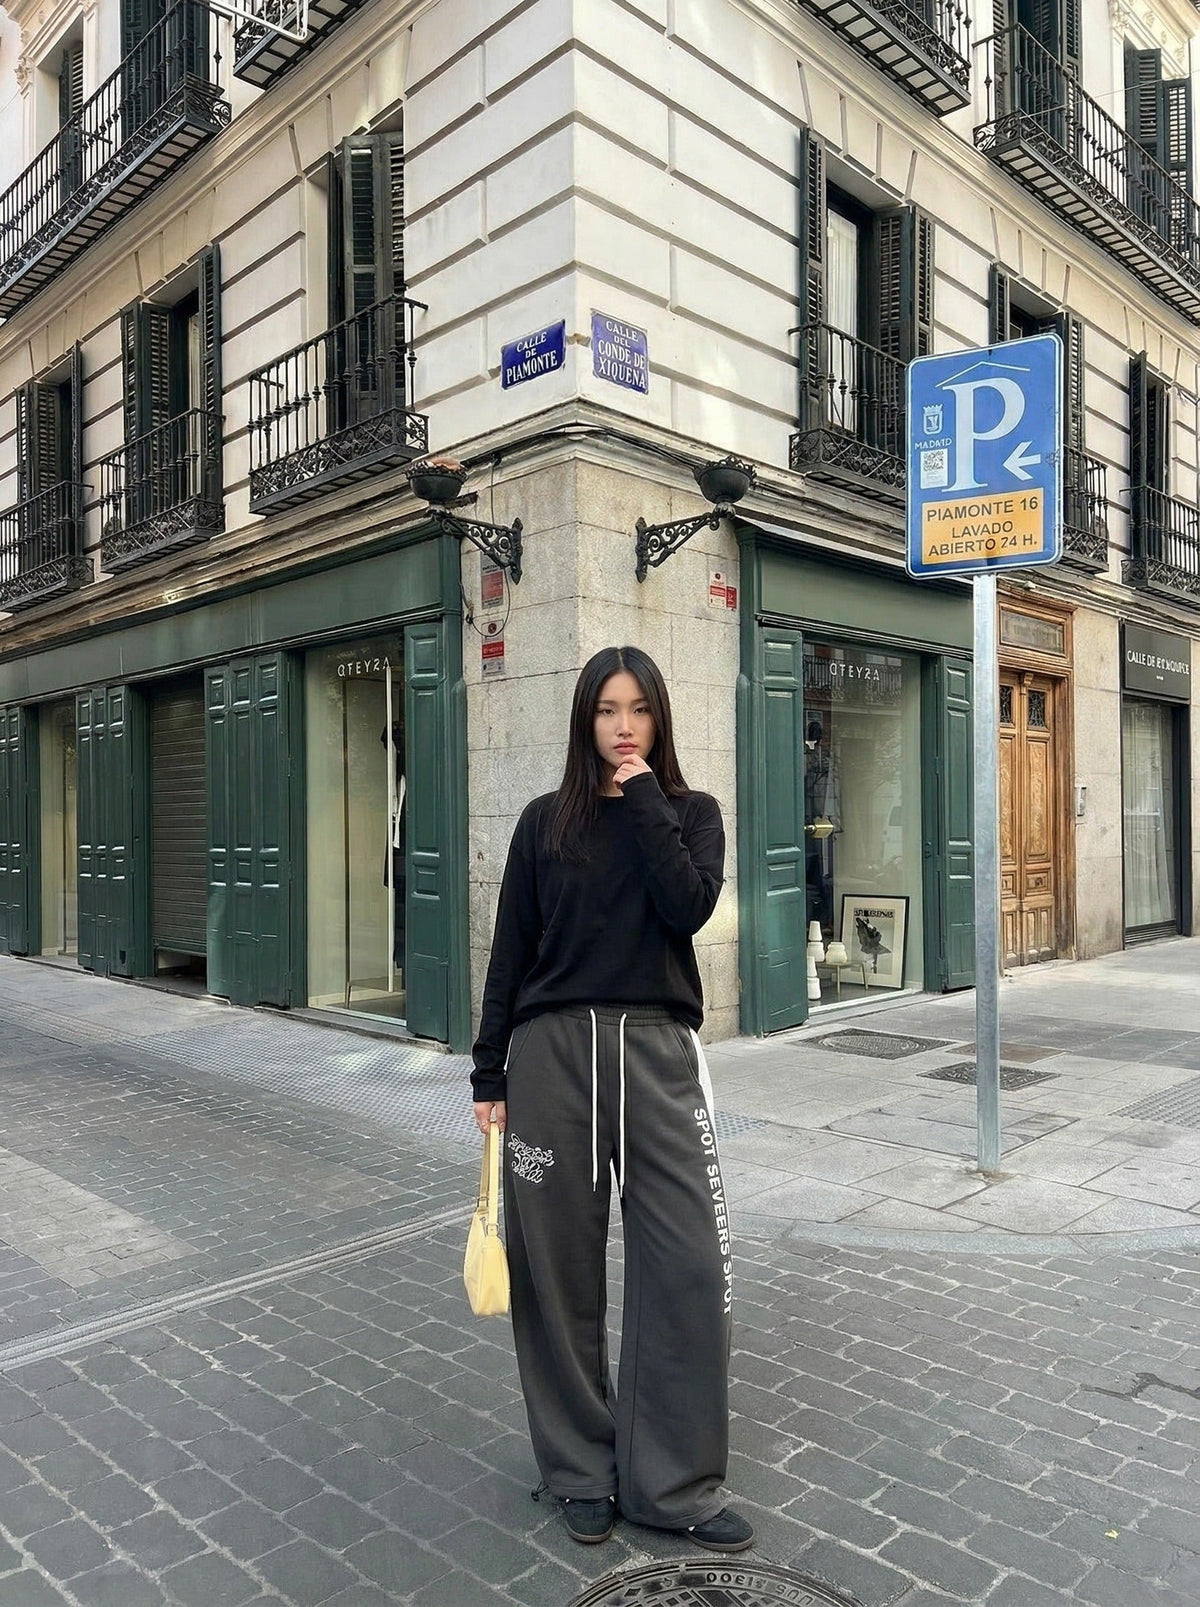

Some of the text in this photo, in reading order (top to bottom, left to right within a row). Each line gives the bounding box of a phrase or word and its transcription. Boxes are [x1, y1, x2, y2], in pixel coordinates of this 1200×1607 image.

[516, 331, 547, 353] CALLE
[606, 320, 638, 342] CALLE
[613, 336, 631, 348] DEL
[525, 348, 537, 359] DE
[598, 340, 646, 370] CONDE DE
[506, 350, 557, 384] PIAMONTE
[598, 357, 646, 390] XIQUENA
[942, 377, 1025, 492] P
[927, 496, 1038, 521] PIAMONTE 16
[952, 520, 1013, 538] LAVADO
[928, 533, 1038, 556] ABIERTO 24 H.
[1127, 650, 1146, 666] CALLE
[694, 1107, 717, 1158] SPOT
[706, 1163, 731, 1256] SEVEERS
